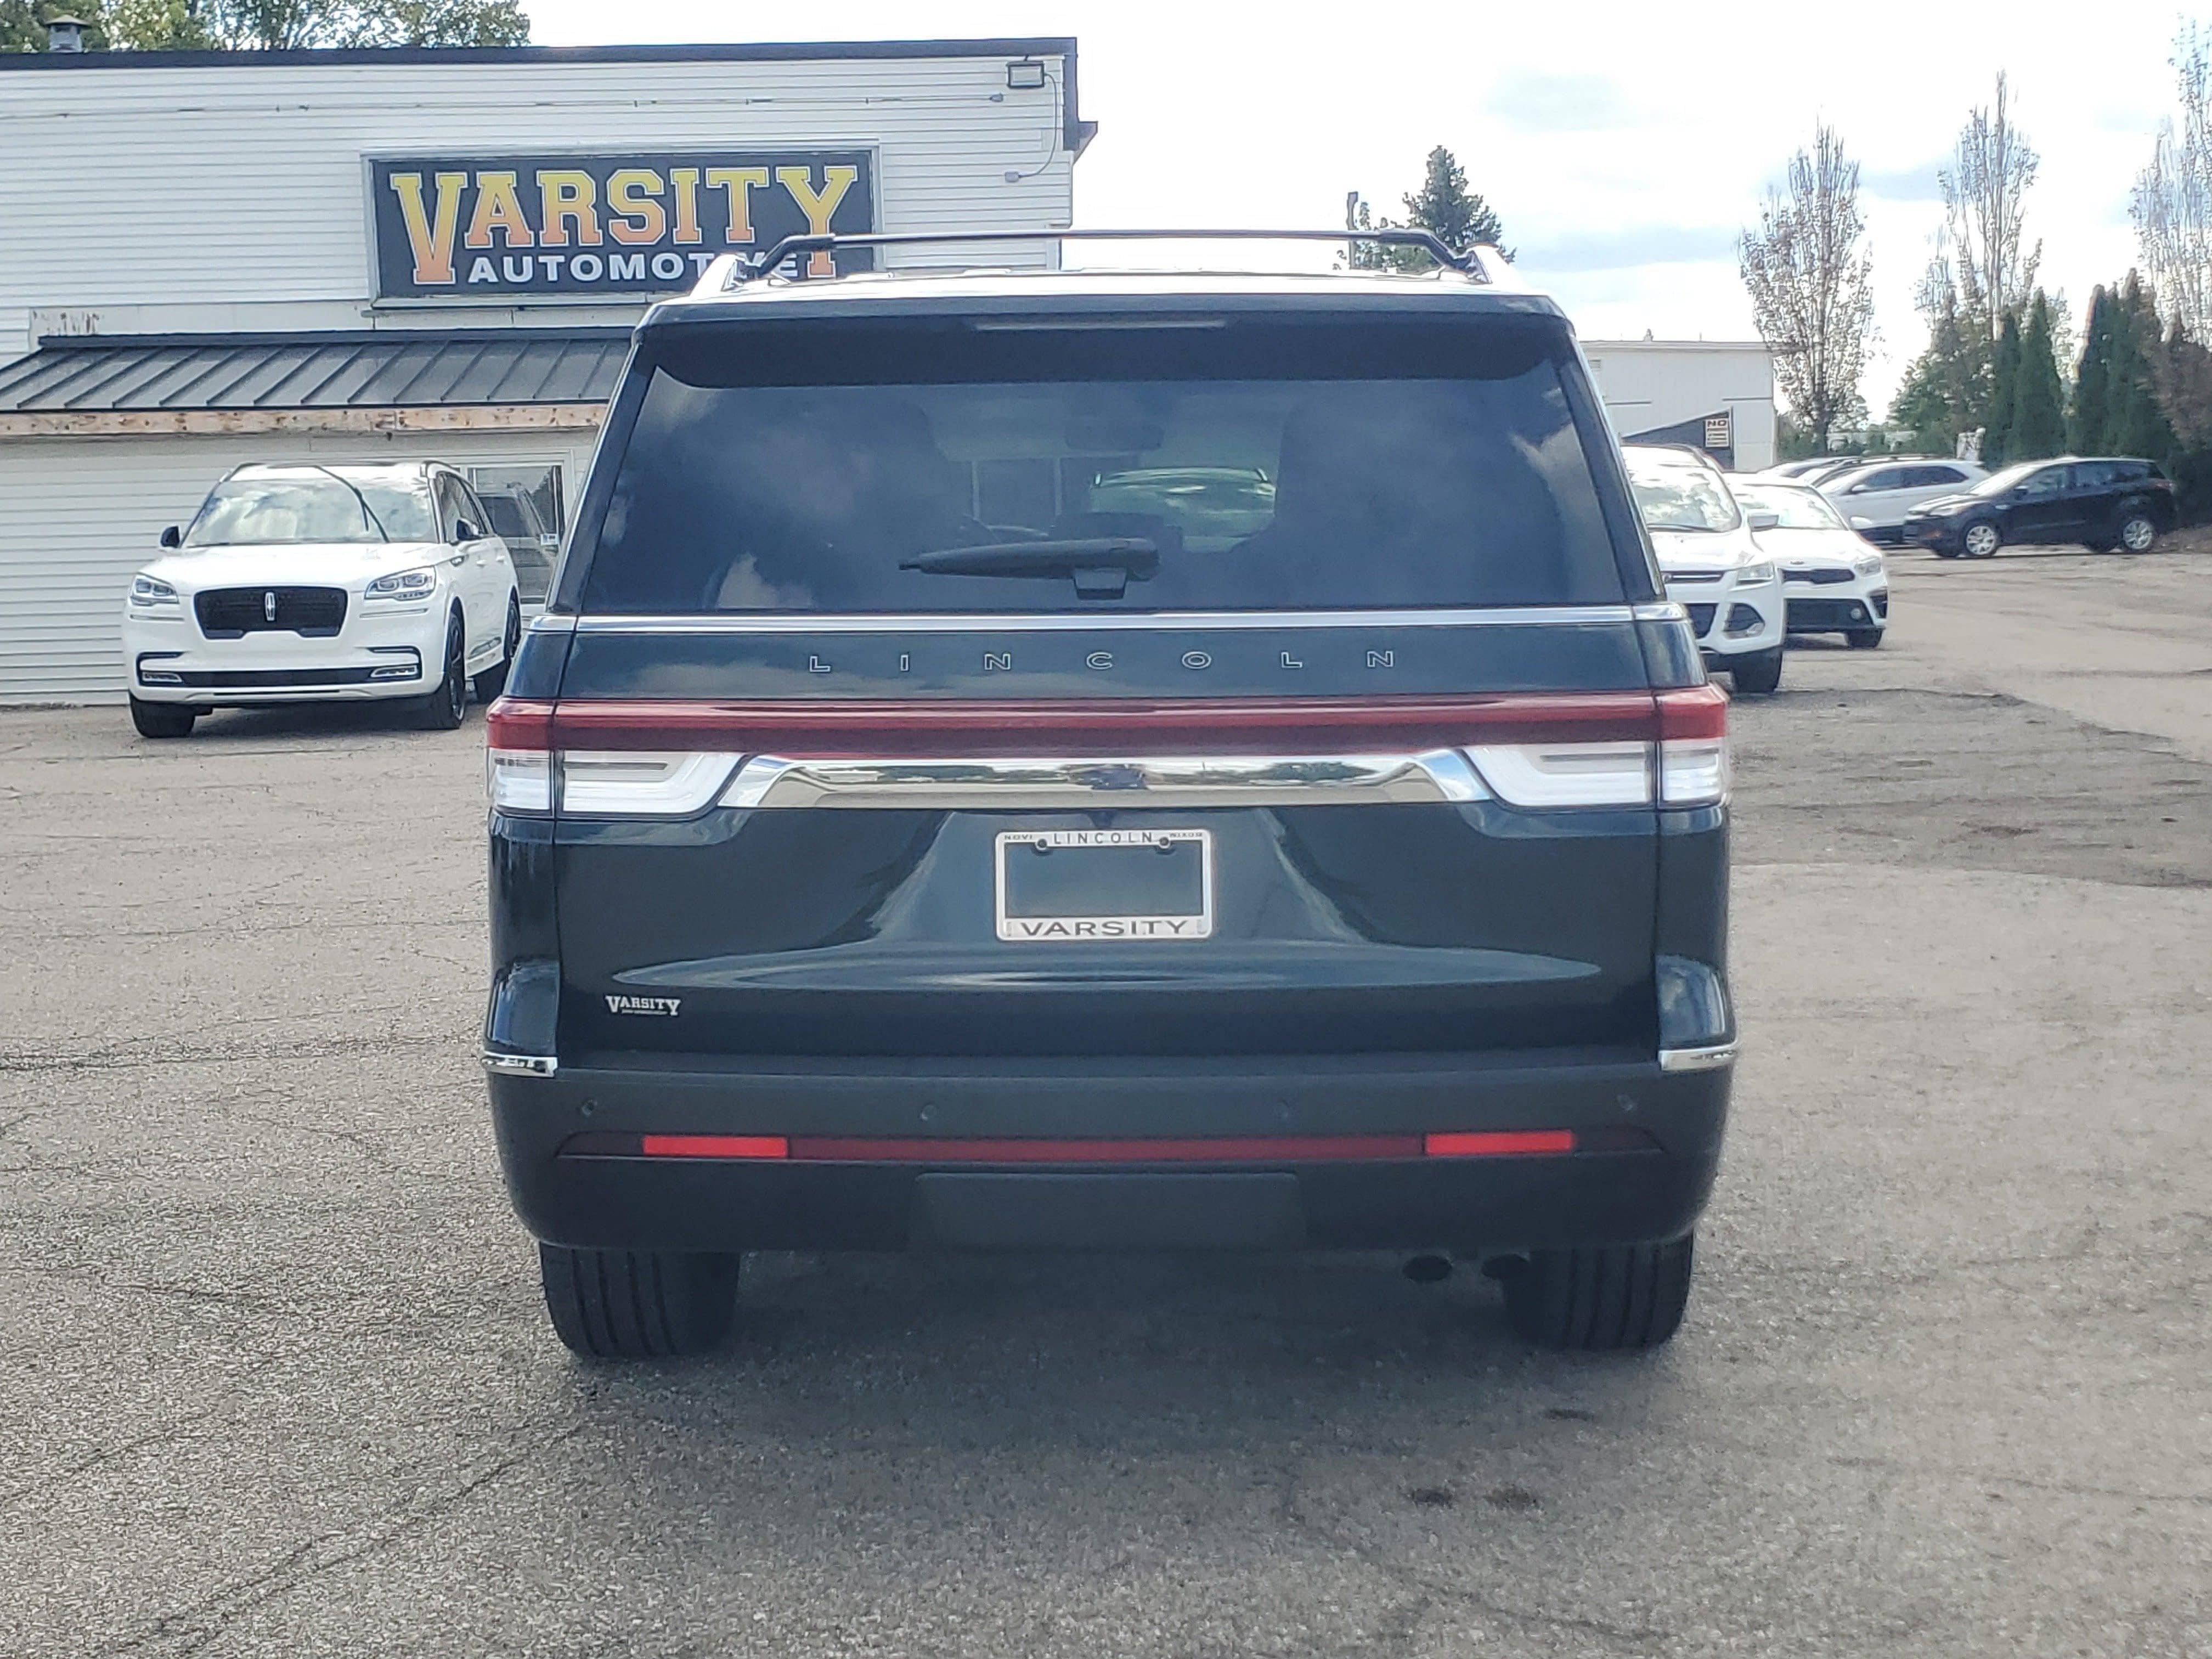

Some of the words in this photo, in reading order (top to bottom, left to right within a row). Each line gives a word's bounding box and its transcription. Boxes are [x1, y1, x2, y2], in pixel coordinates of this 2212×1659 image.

[390, 166, 857, 285] VARSITY
[468, 251, 798, 283] AUTOMOTE
[809, 650, 1394, 673] LINCOLN
[1054, 832, 1152, 845] LINCOLN
[1020, 920, 1189, 936] VARSITY
[605, 995, 681, 1016] VARSITY
